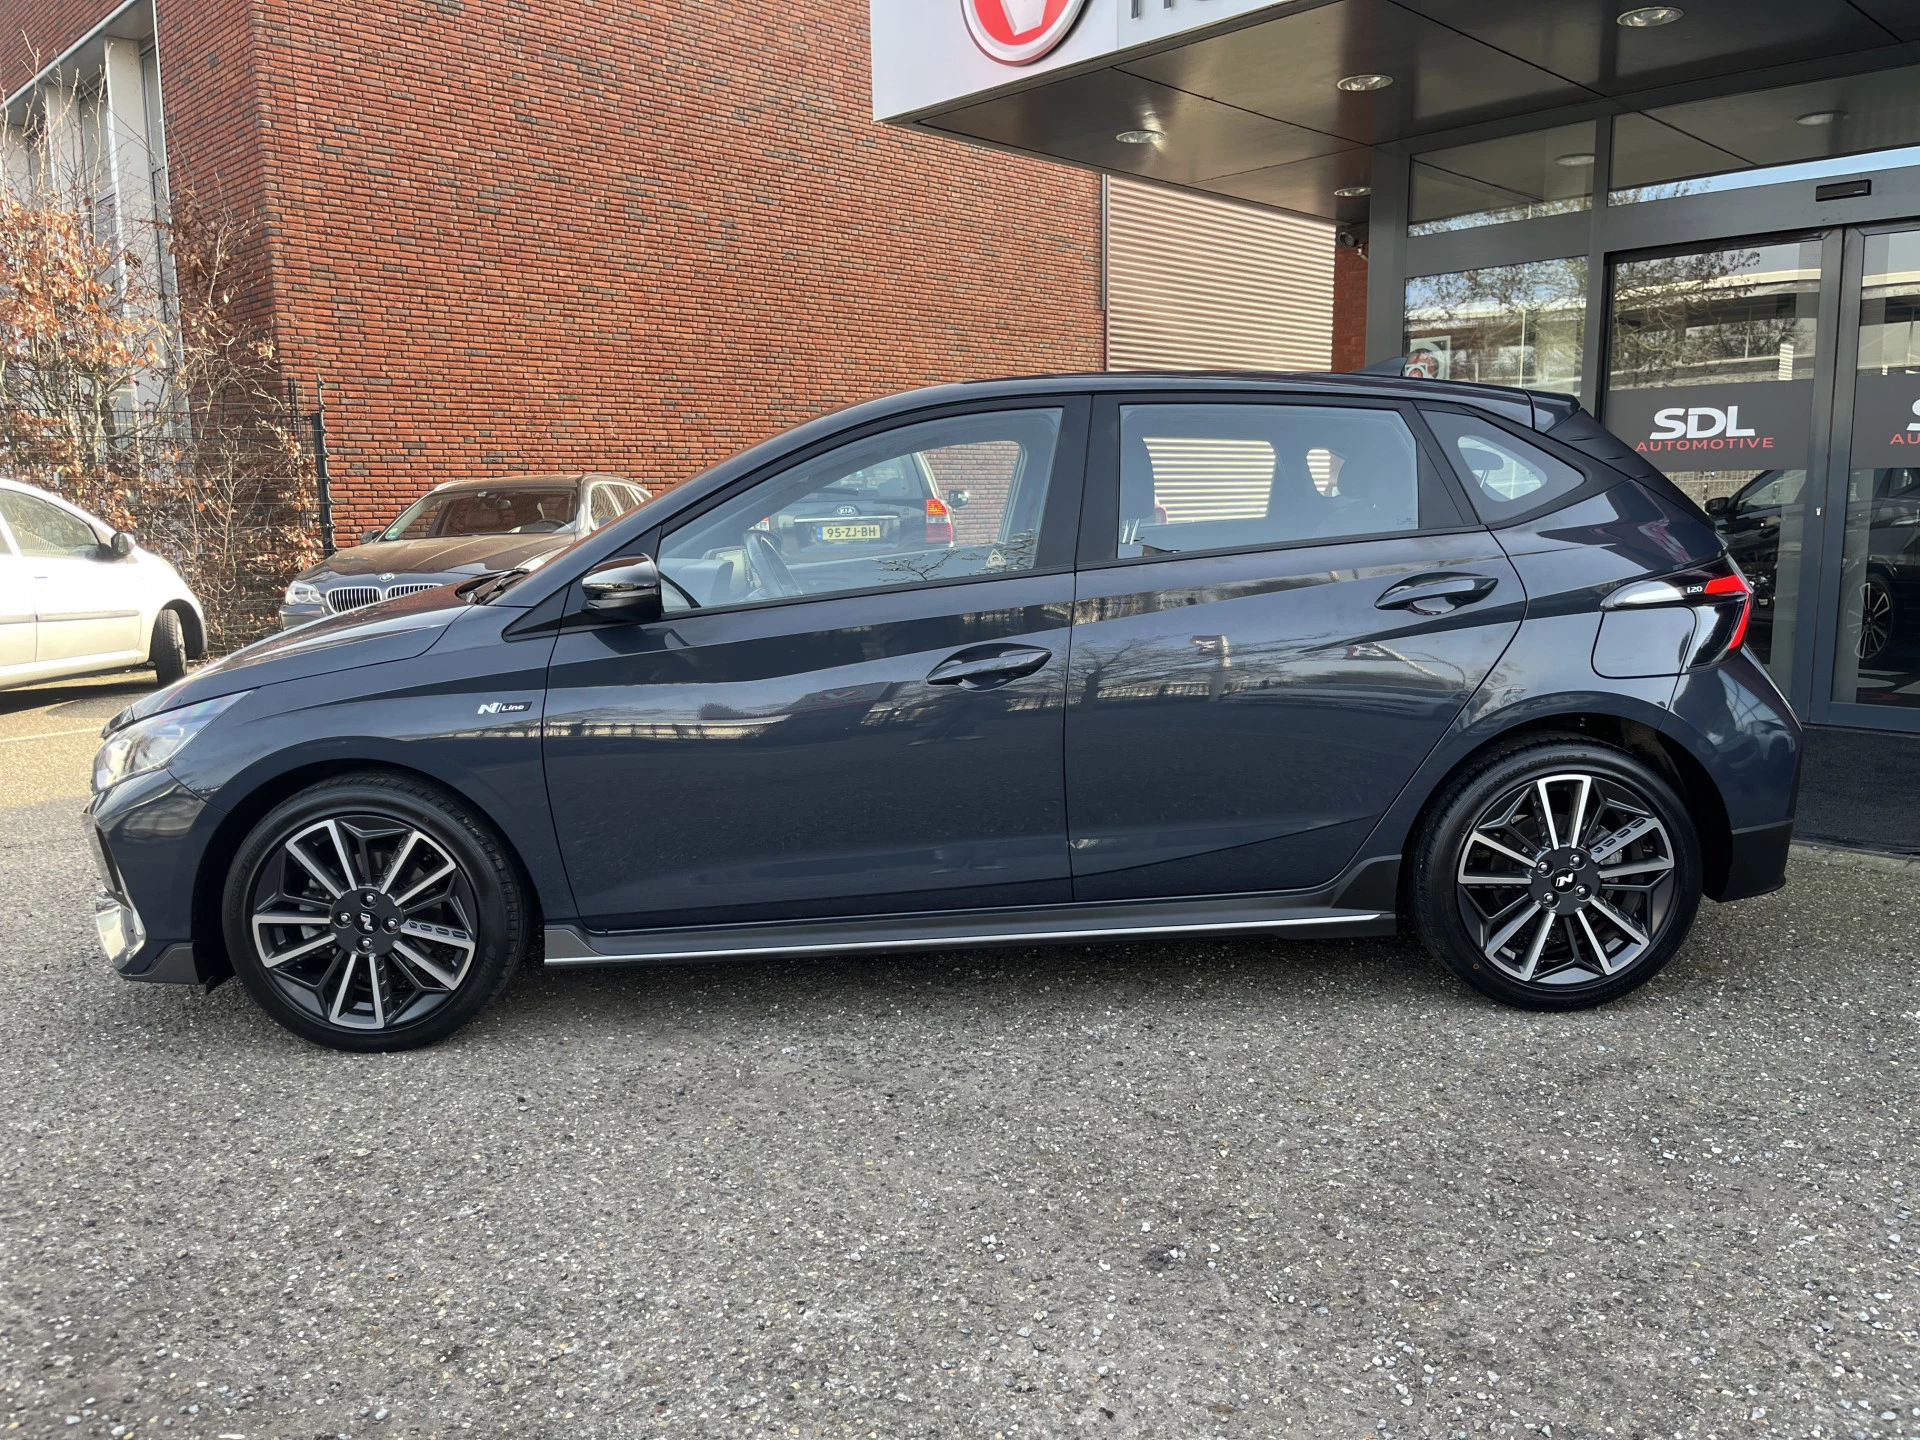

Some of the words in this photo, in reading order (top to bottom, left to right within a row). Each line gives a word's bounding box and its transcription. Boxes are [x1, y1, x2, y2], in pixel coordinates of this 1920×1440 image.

[1649, 405, 1756, 440] SDL
[1634, 437, 1775, 452] AUTOMOTIVE
[826, 526, 876, 538] 95-ZJ-BH
